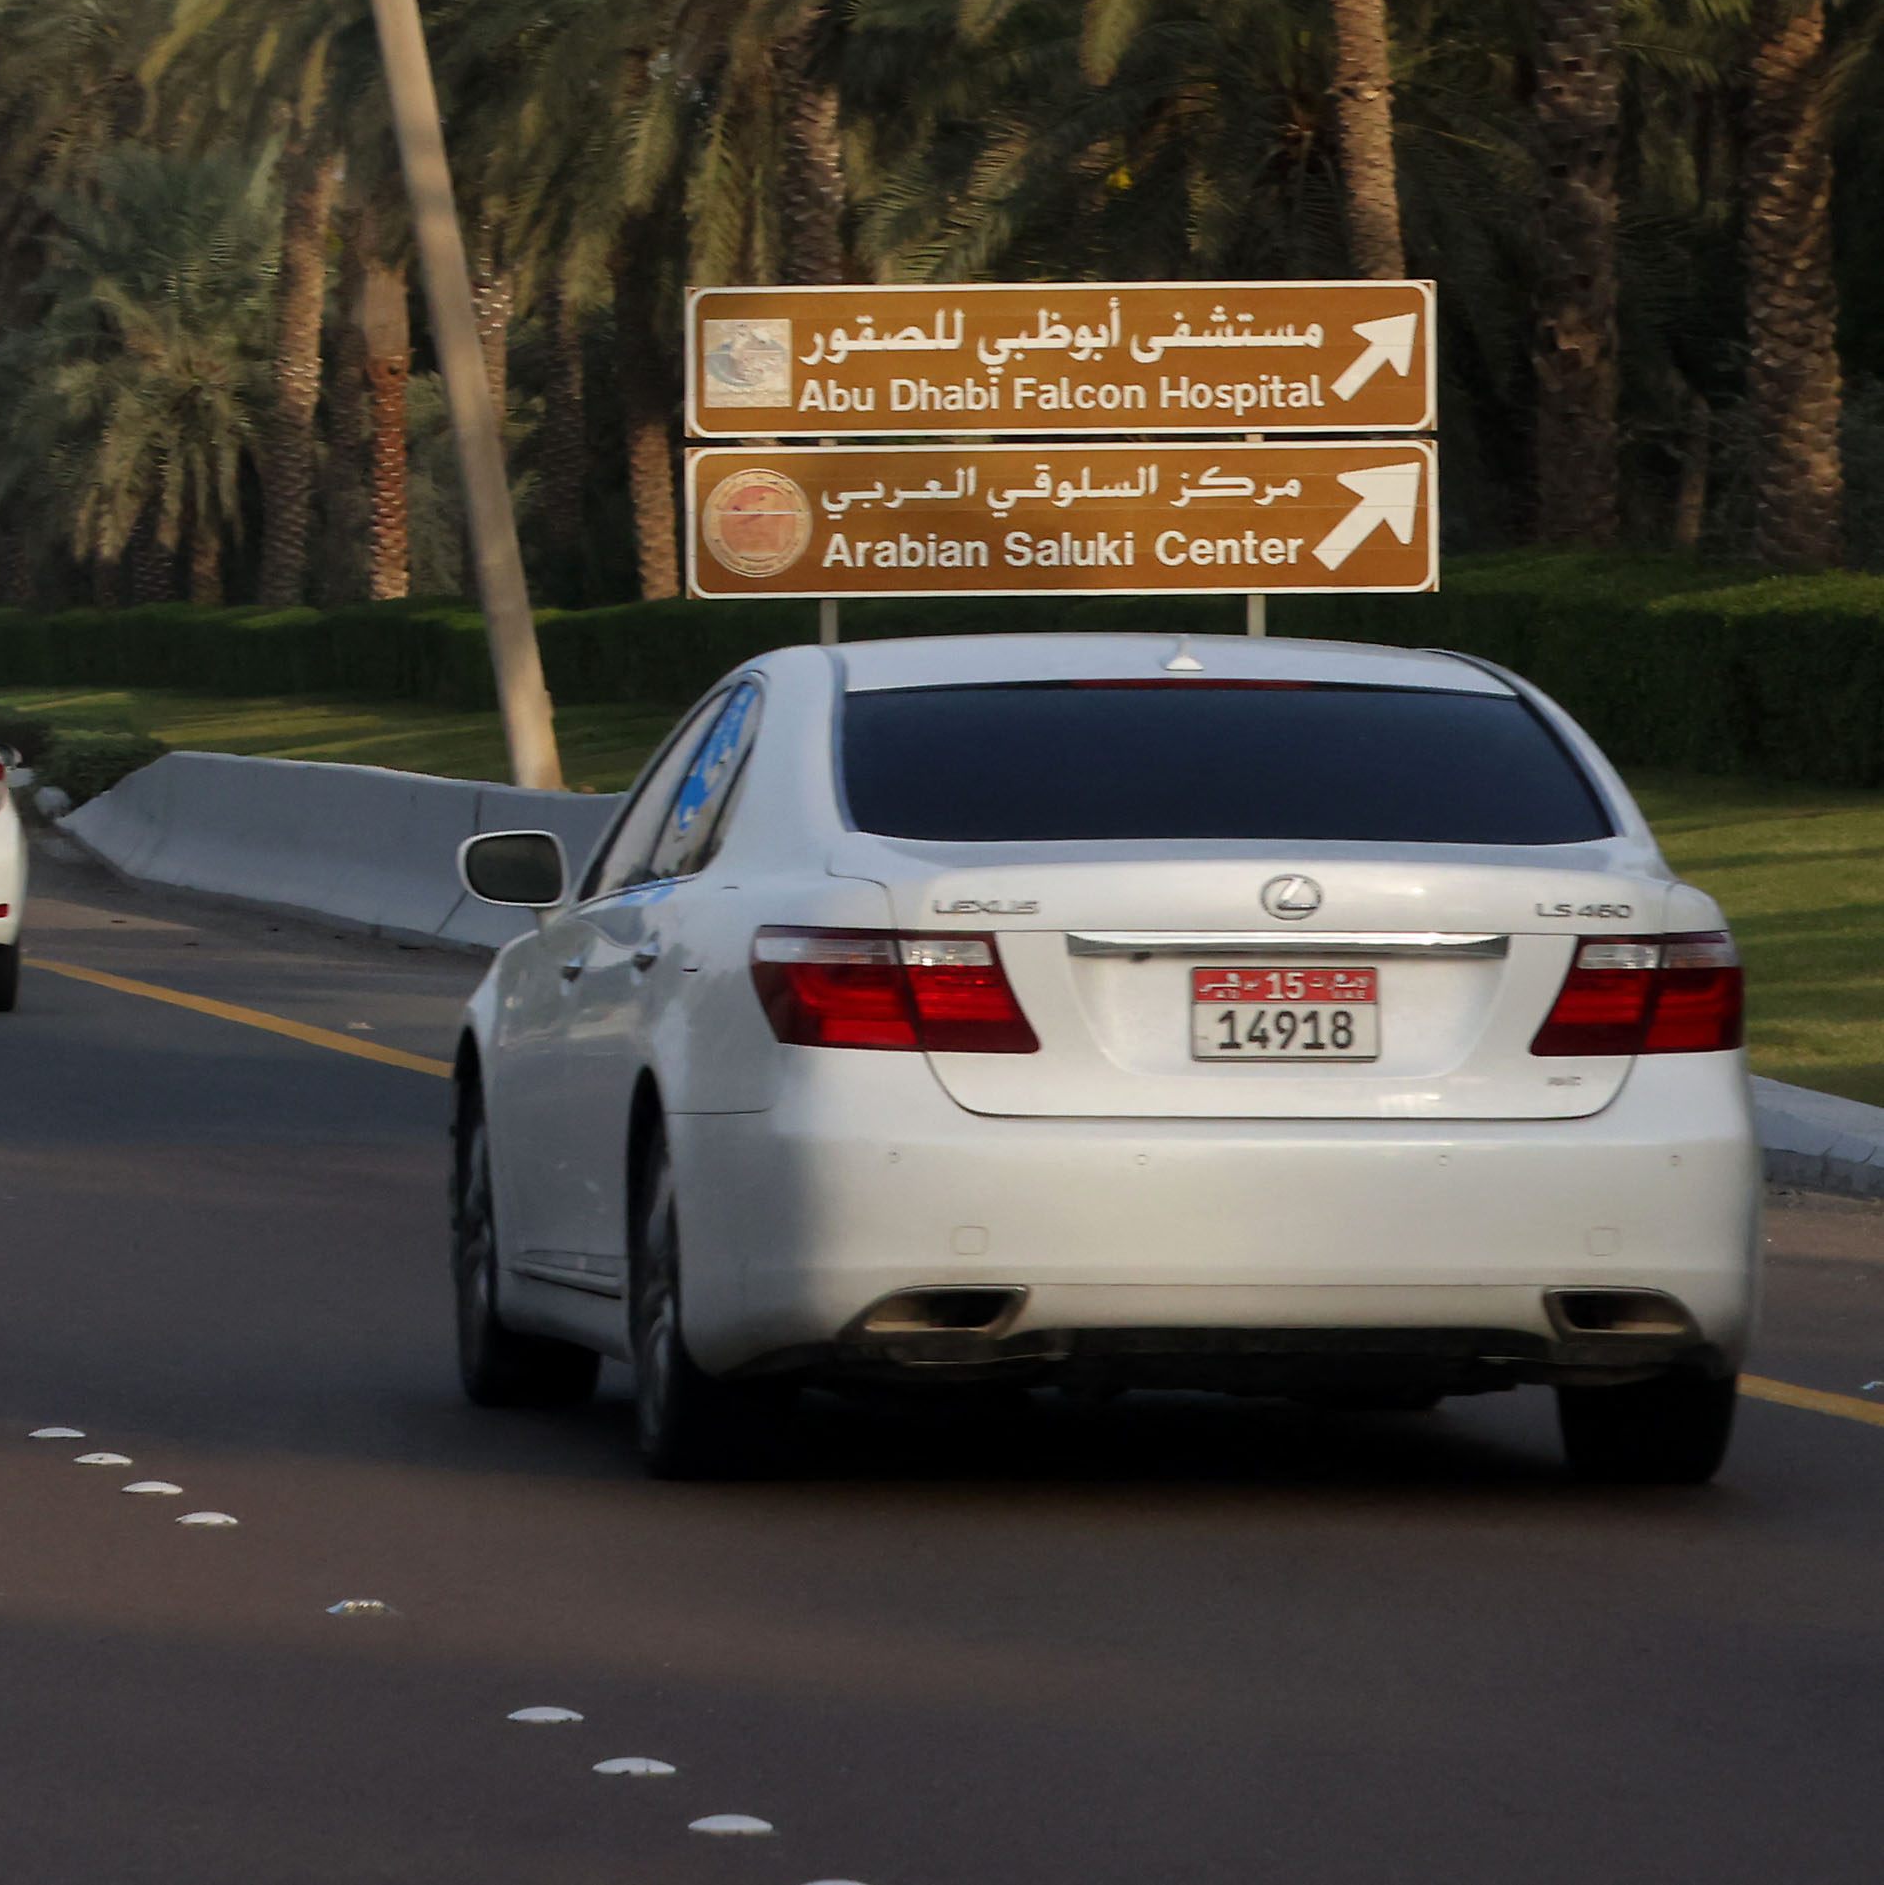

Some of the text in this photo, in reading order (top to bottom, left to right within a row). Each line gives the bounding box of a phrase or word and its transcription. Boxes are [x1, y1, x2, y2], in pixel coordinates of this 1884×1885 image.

[798, 308, 965, 366] للصقور
[1130, 305, 1324, 364] مستشفى
[797, 374, 1325, 417] Abu Dhabi Falcon Hospital
[821, 463, 1302, 520] مركز السلوقي العربي
[822, 530, 1305, 568] Arabian Saluki Center
[933, 899, 1040, 914] LEXUS
[1266, 972, 1306, 1000] 15
[1218, 1009, 1354, 1050] 14918
